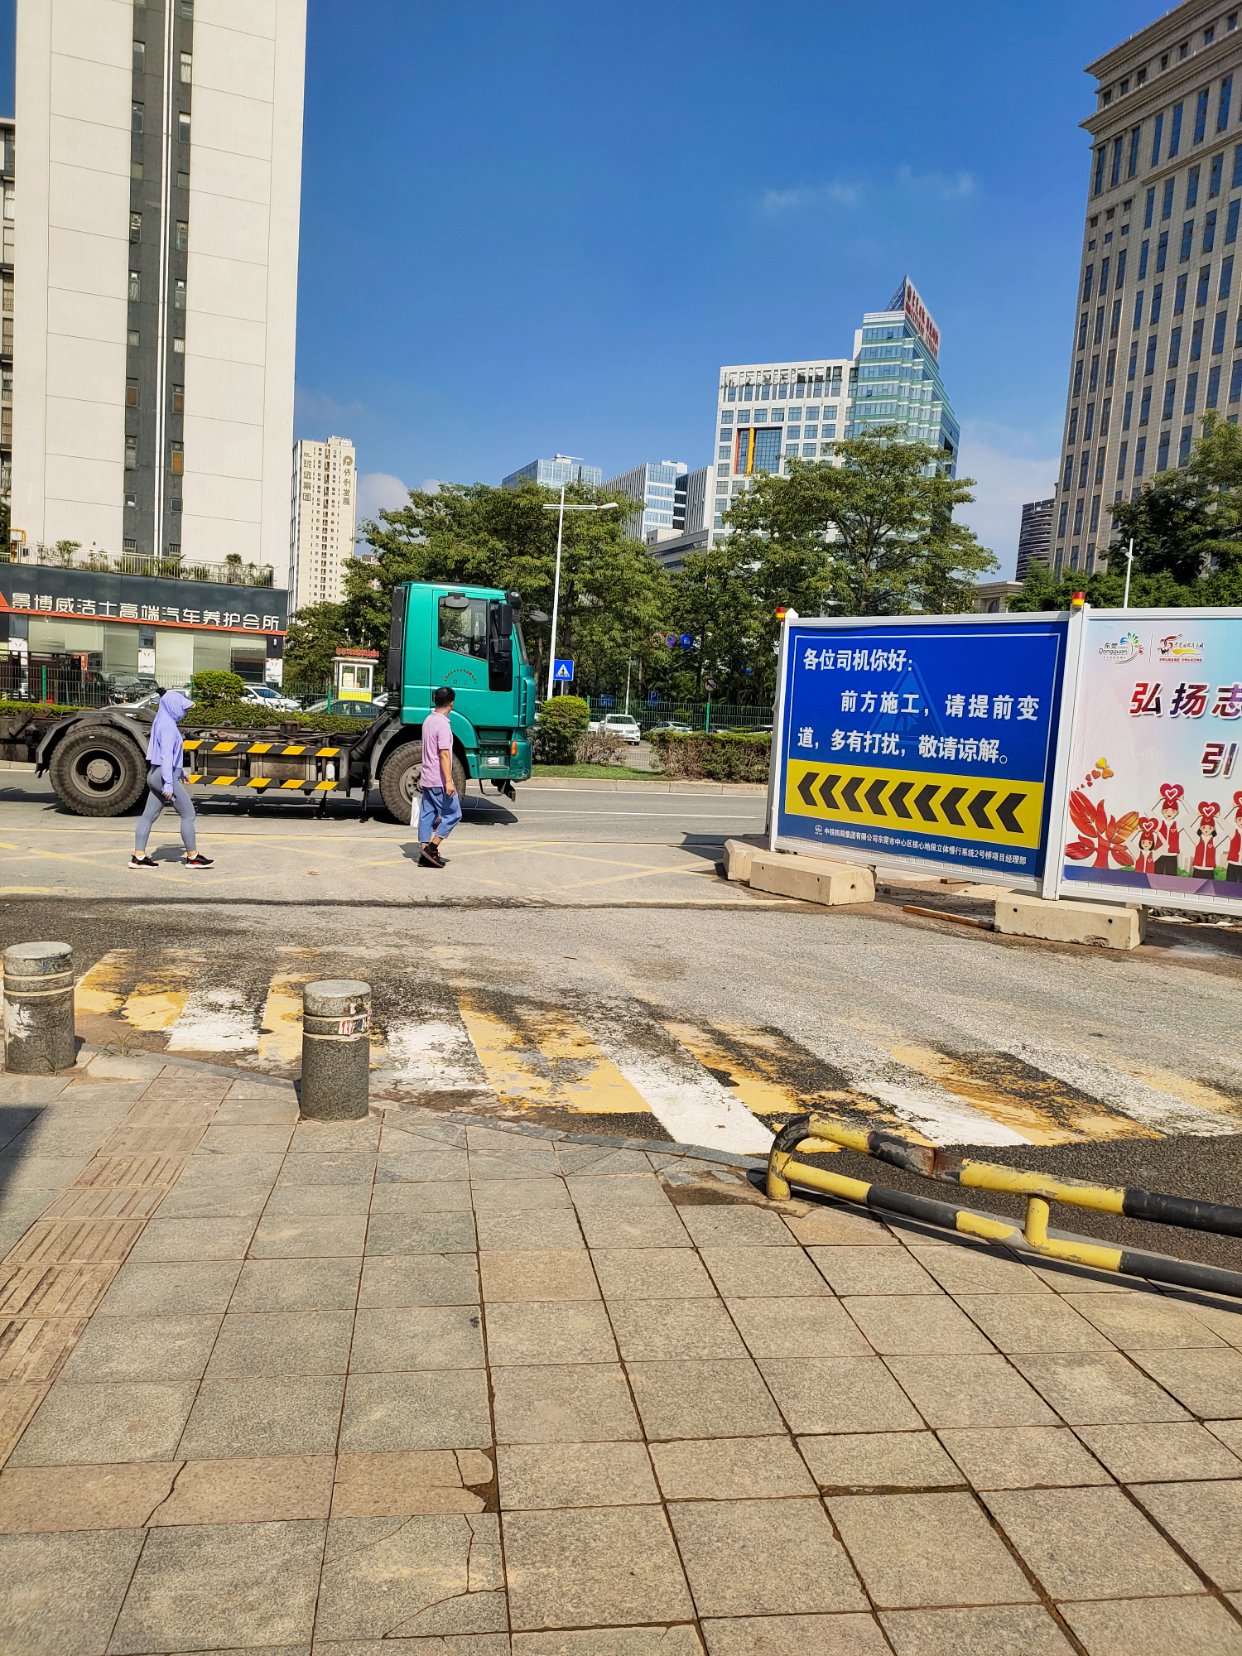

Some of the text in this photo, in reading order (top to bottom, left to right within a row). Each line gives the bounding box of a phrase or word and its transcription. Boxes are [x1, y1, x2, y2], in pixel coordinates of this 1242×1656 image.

[12, 592, 279, 631] 景博威洁士高端汽车养护会所
[803, 647, 912, 672] 各位司机你好：
[841, 690, 1040, 721] 前方施工，请提前变
[1130, 682, 1242, 717] 弘扬志
[797, 726, 1008, 765] 道，多有打扰，敬请谅解。
[1201, 743, 1237, 776] 引
